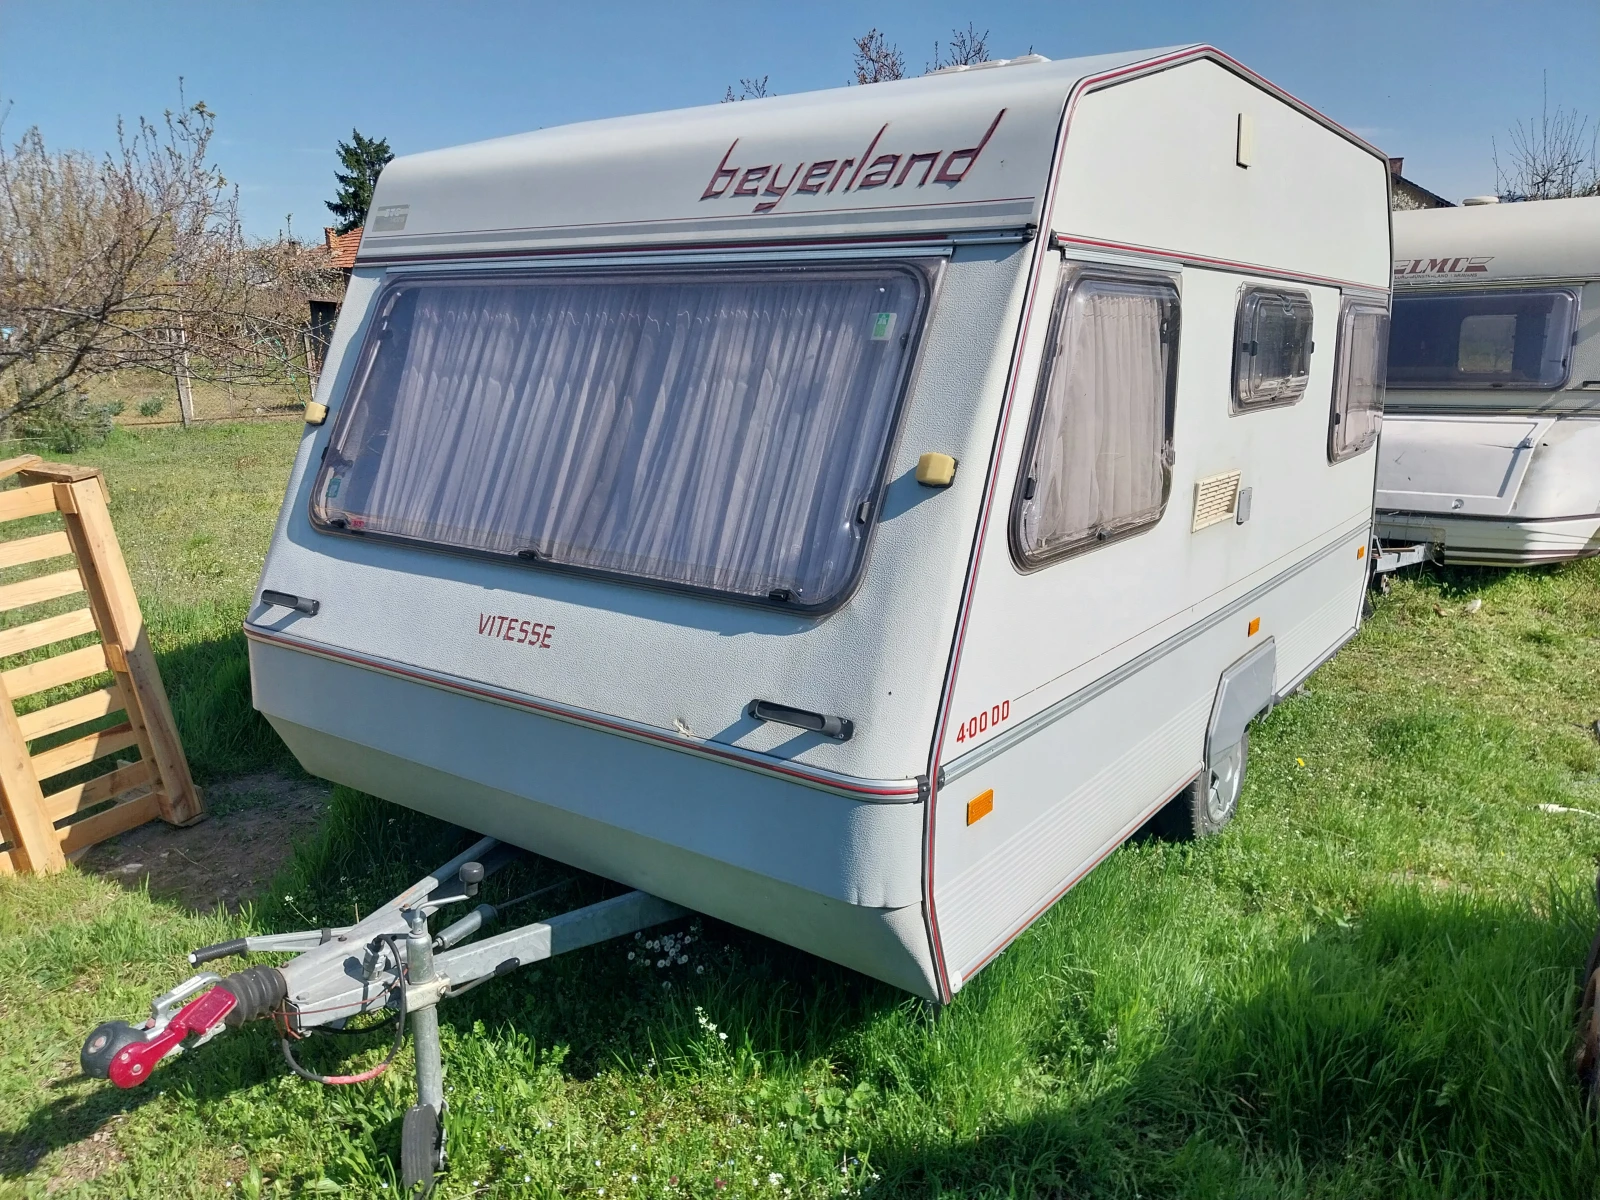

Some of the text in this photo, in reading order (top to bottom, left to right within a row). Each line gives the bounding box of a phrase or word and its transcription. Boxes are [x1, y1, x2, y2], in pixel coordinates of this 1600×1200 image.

[700, 107, 1007, 212] beyerland
[1406, 257, 1469, 274] LMC
[478, 613, 556, 649] VITESSE
